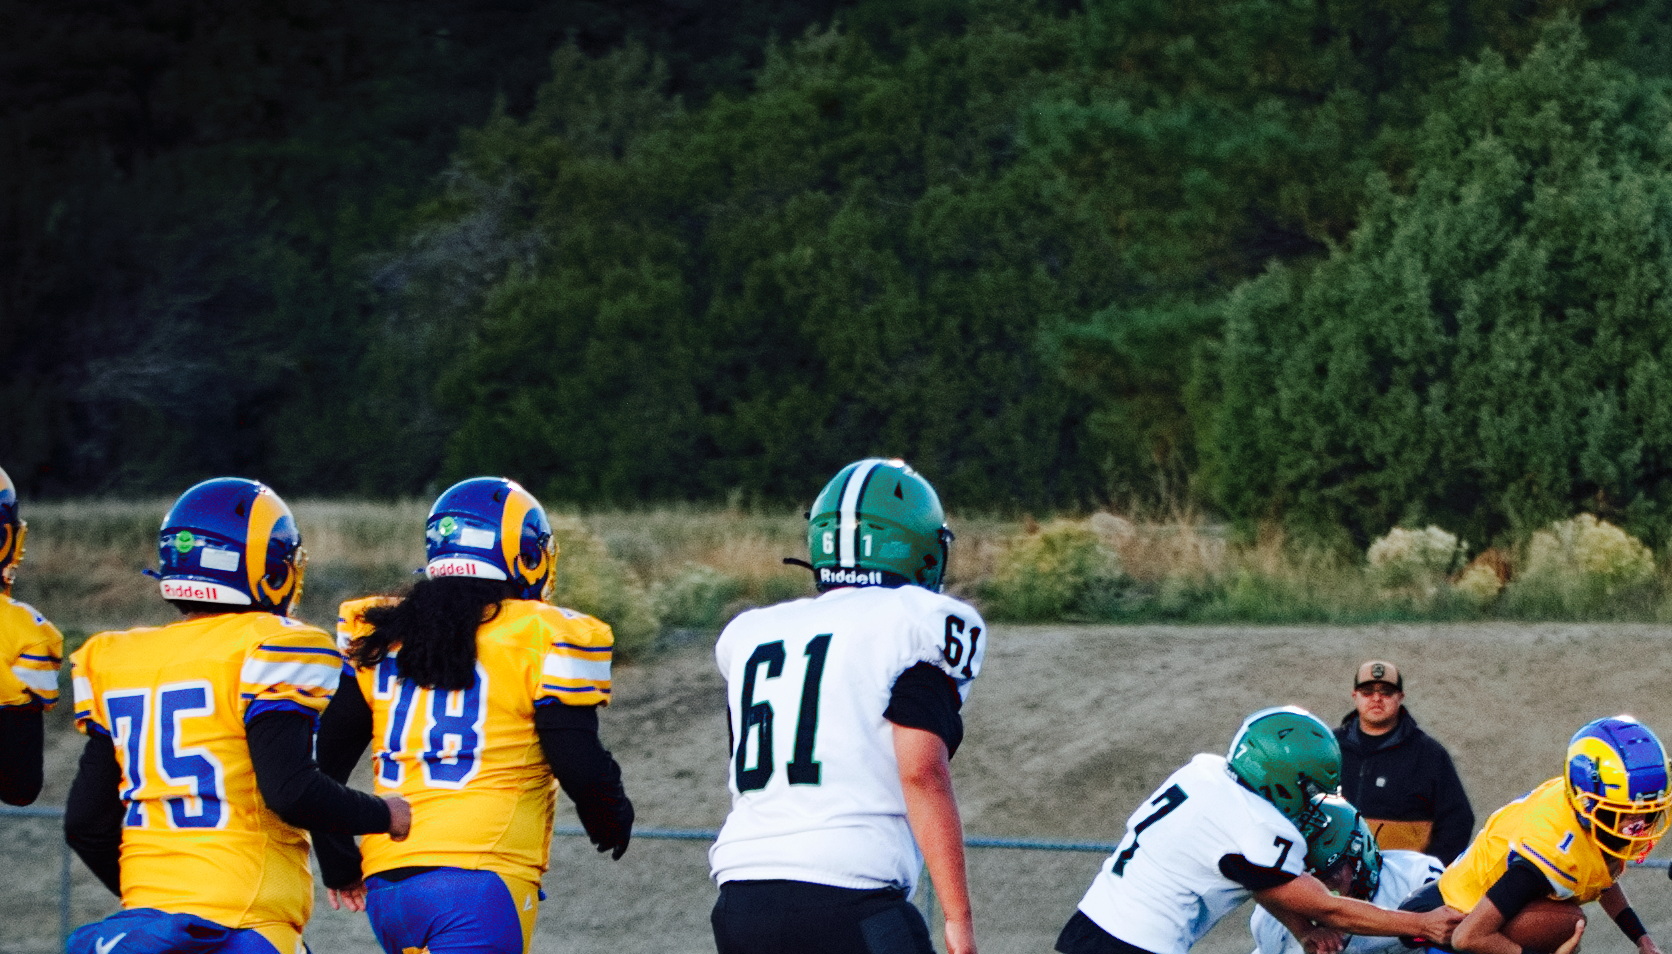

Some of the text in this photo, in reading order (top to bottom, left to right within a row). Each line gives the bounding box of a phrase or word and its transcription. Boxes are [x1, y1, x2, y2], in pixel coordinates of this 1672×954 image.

[164, 584, 217, 600] Riddell
[429, 563, 477, 576] Riddell
[820, 567, 882, 585] Riddell
[944, 614, 982, 679] 61
[373, 650, 489, 790] 78
[735, 633, 833, 794] 61
[102, 678, 230, 832] 75
[1111, 783, 1189, 878] 7
[1272, 835, 1294, 871] 7
[1555, 830, 1575, 855] 1
